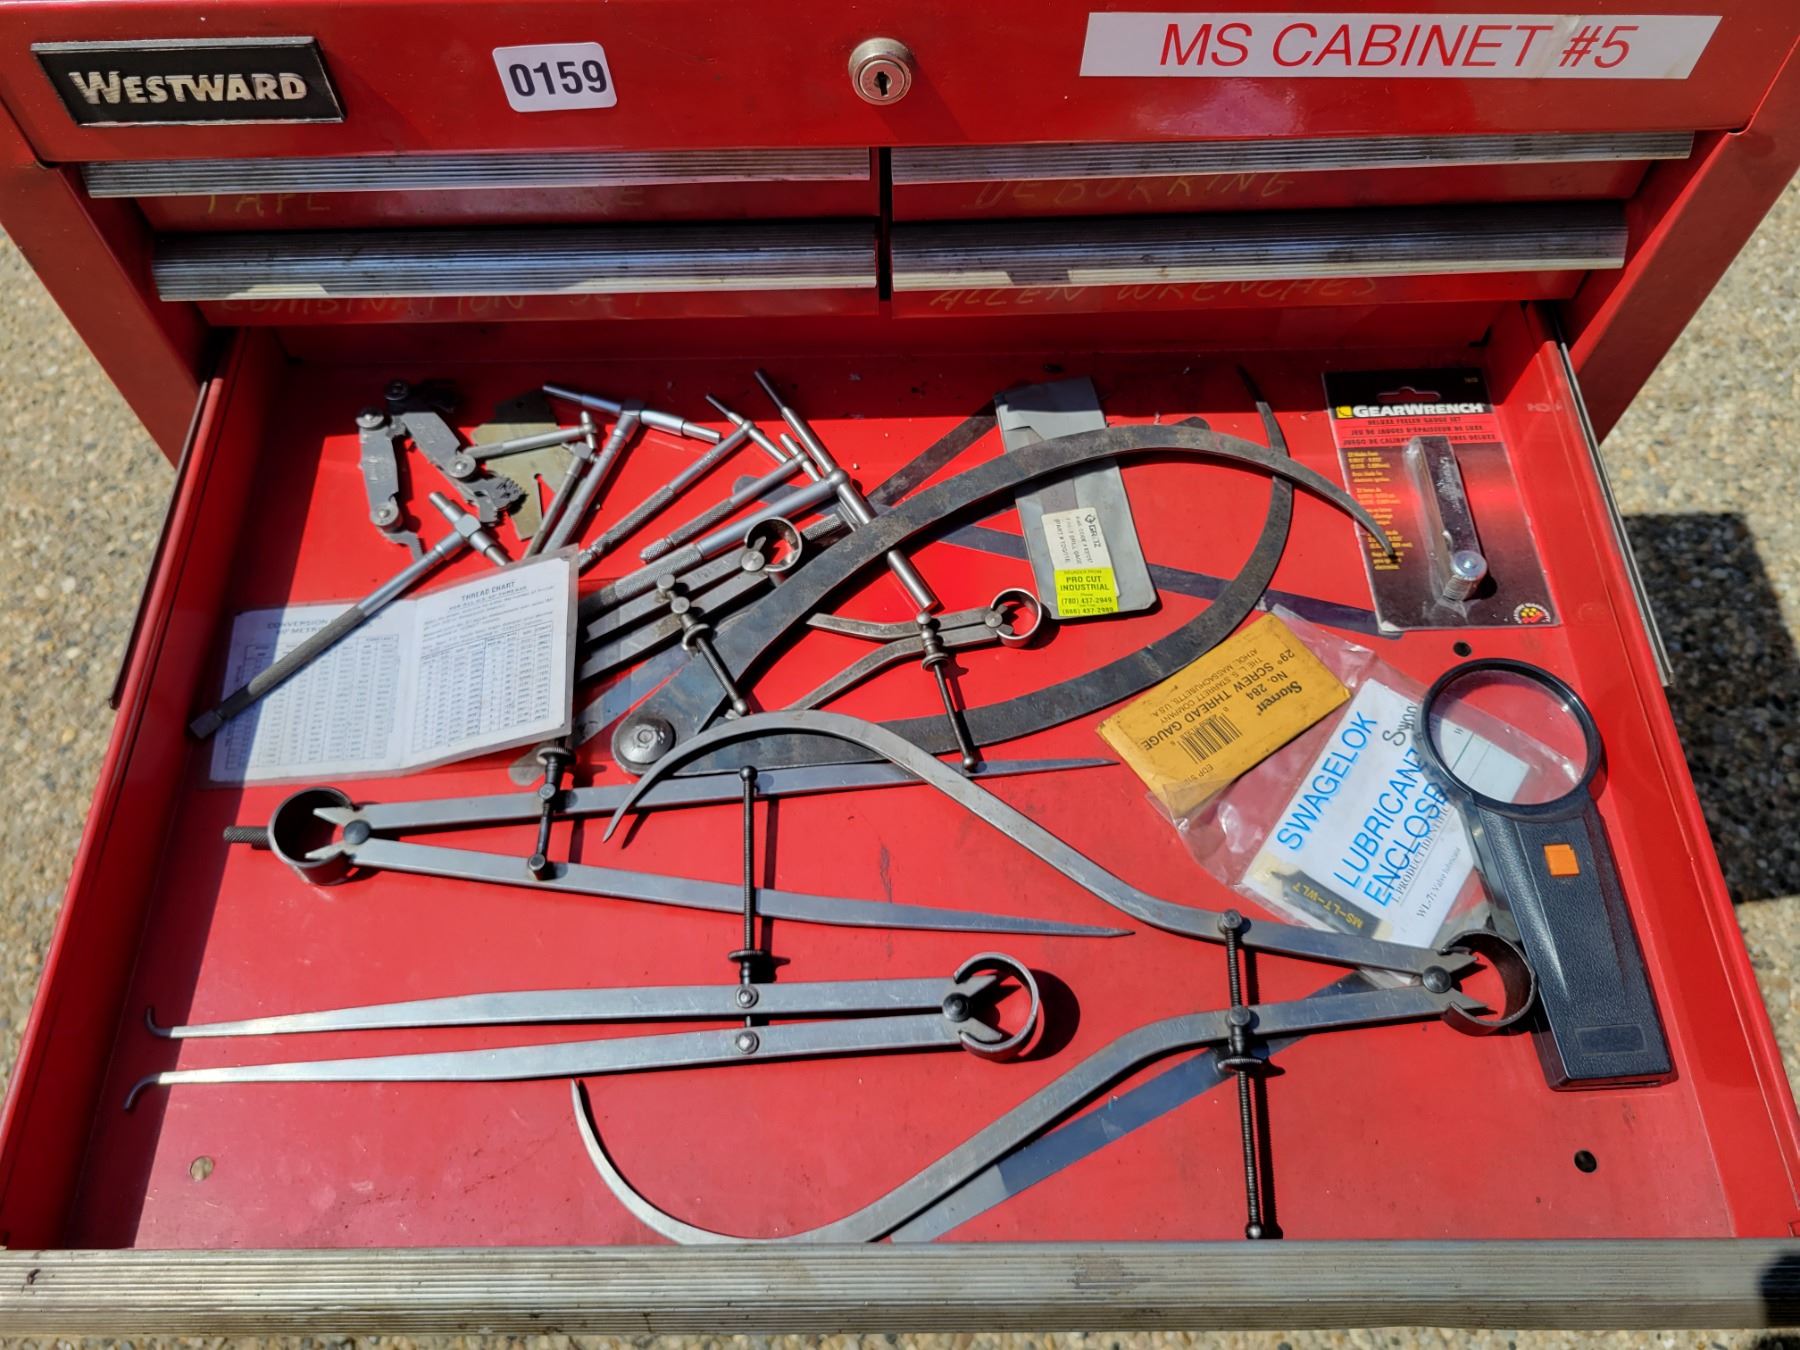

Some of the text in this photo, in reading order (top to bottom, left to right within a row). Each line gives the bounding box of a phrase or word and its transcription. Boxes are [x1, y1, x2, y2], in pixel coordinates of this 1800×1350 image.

[1159, 23, 1639, 67] MS CABINET #5
[69, 71, 307, 104] WESTWARD
[509, 60, 607, 97] 0159
[1353, 403, 1484, 417] GEARWRENCH
[491, 581, 516, 594] CHART
[1060, 583, 1110, 592] INDUSTRIAL
[1086, 575, 1102, 583] CUT
[1233, 661, 1275, 693] SCREW
[1252, 657, 1263, 668] THE
[1196, 677, 1232, 702] STARRETT
[1245, 670, 1288, 701] No. 284
[1256, 680, 1303, 716] Starrett
[1159, 695, 1195, 724] COMPANY
[1184, 690, 1232, 724] THREAD
[1140, 721, 1183, 751] GAUGE
[1276, 711, 1378, 850] SWAGELOK
